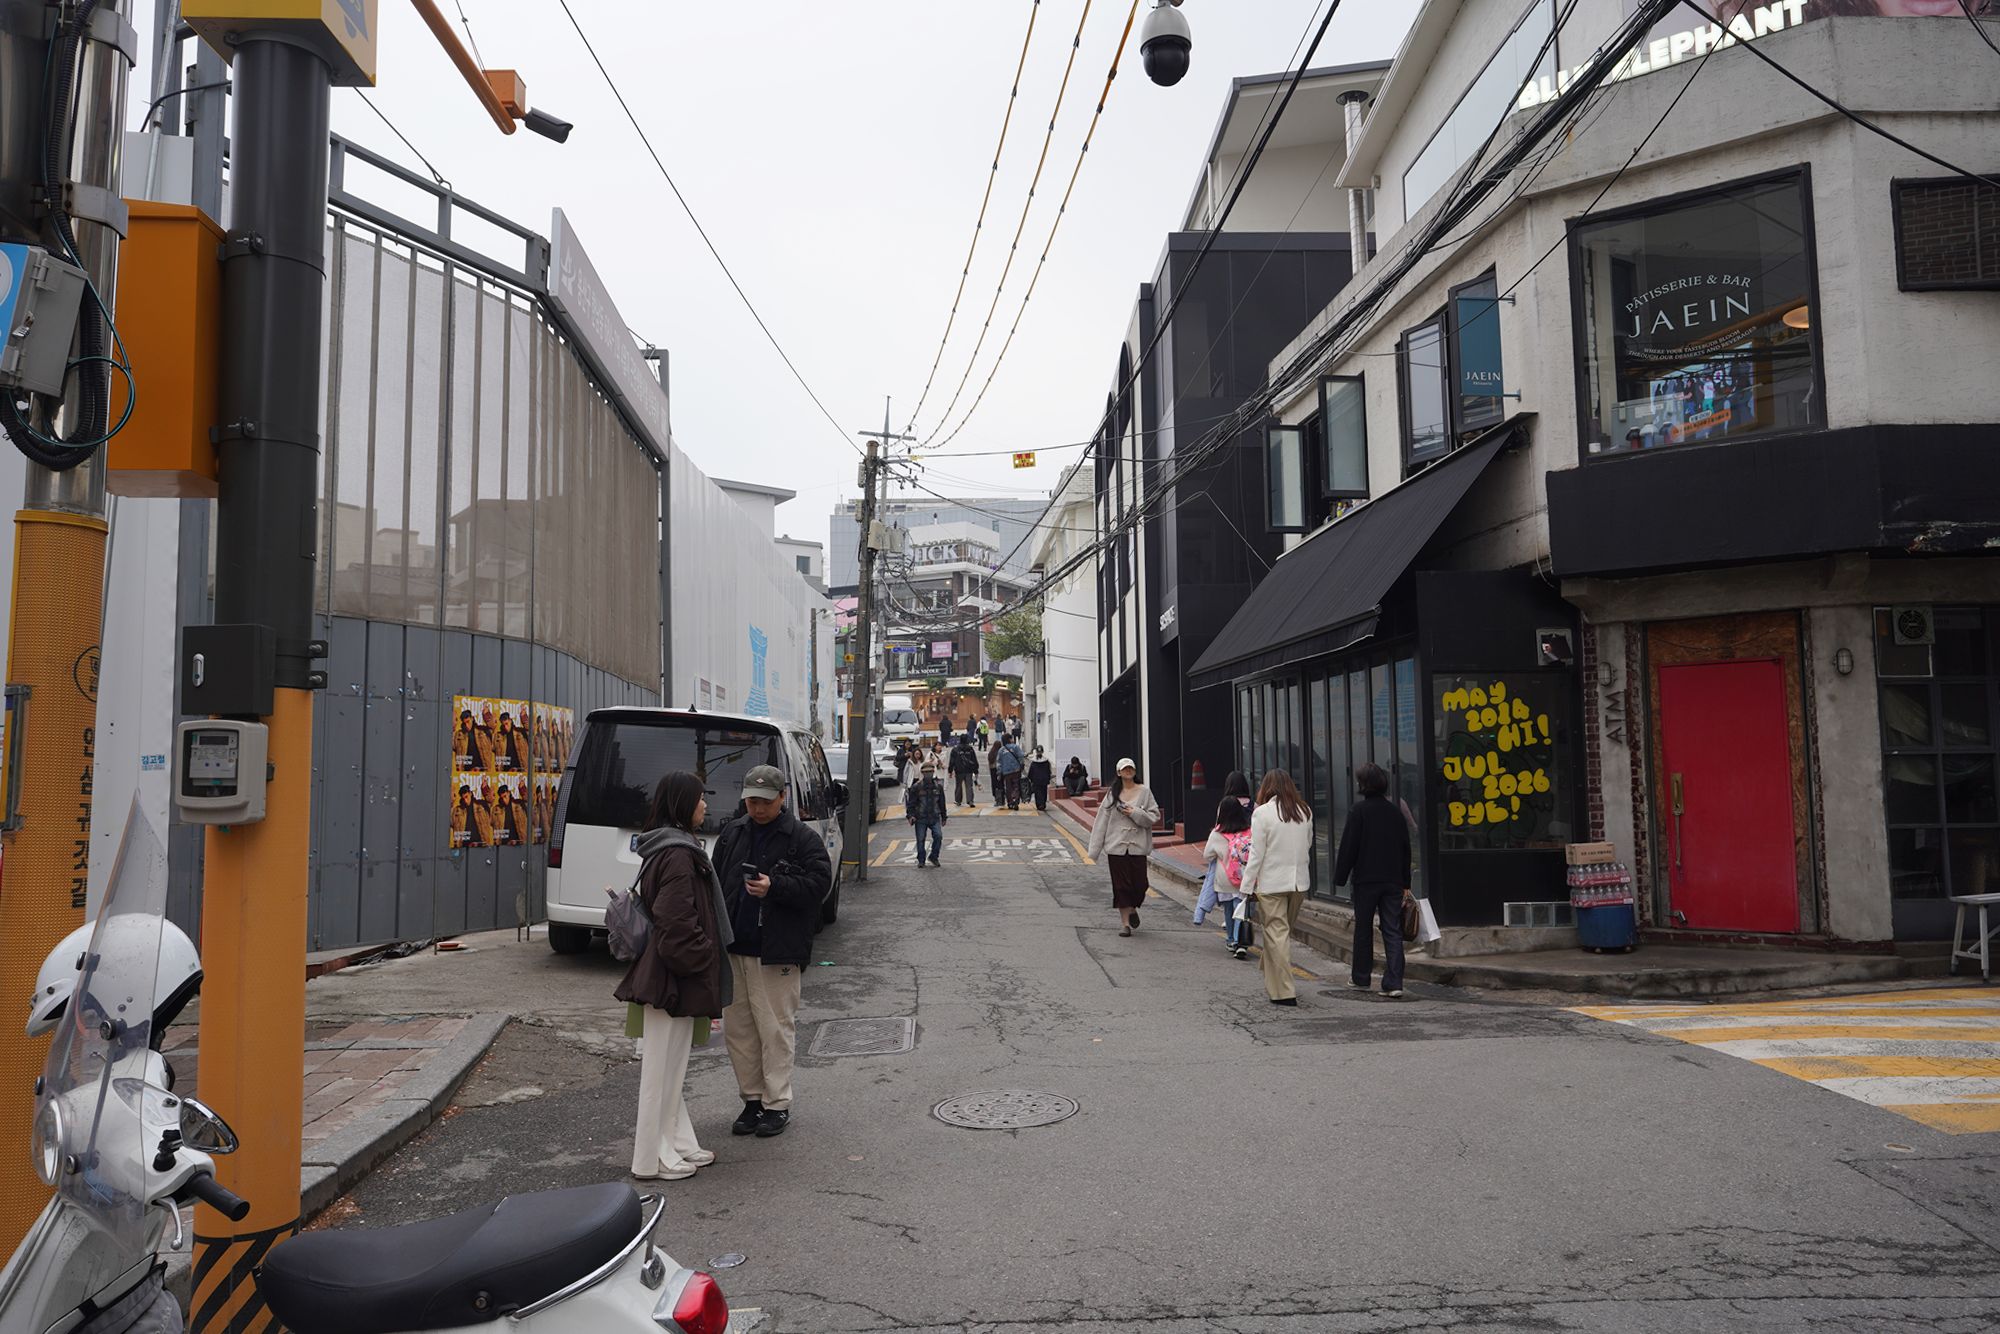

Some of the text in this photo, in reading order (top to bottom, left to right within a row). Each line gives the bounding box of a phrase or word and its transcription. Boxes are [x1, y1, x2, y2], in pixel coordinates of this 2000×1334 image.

[1518, 60, 1599, 110] BLU
[1625, 274, 1751, 312] PÂTISSERIE & BAR
[1628, 292, 1750, 338] JAEIN
[1465, 371, 1501, 381] JAEIN
[1442, 681, 1506, 712] MAY
[1497, 714, 1552, 751] HI!
[1605, 690, 1623, 744] ATM
[1443, 751, 1506, 781] JUL
[1482, 768, 1550, 799] 2026
[1448, 795, 1520, 826] BYE!
